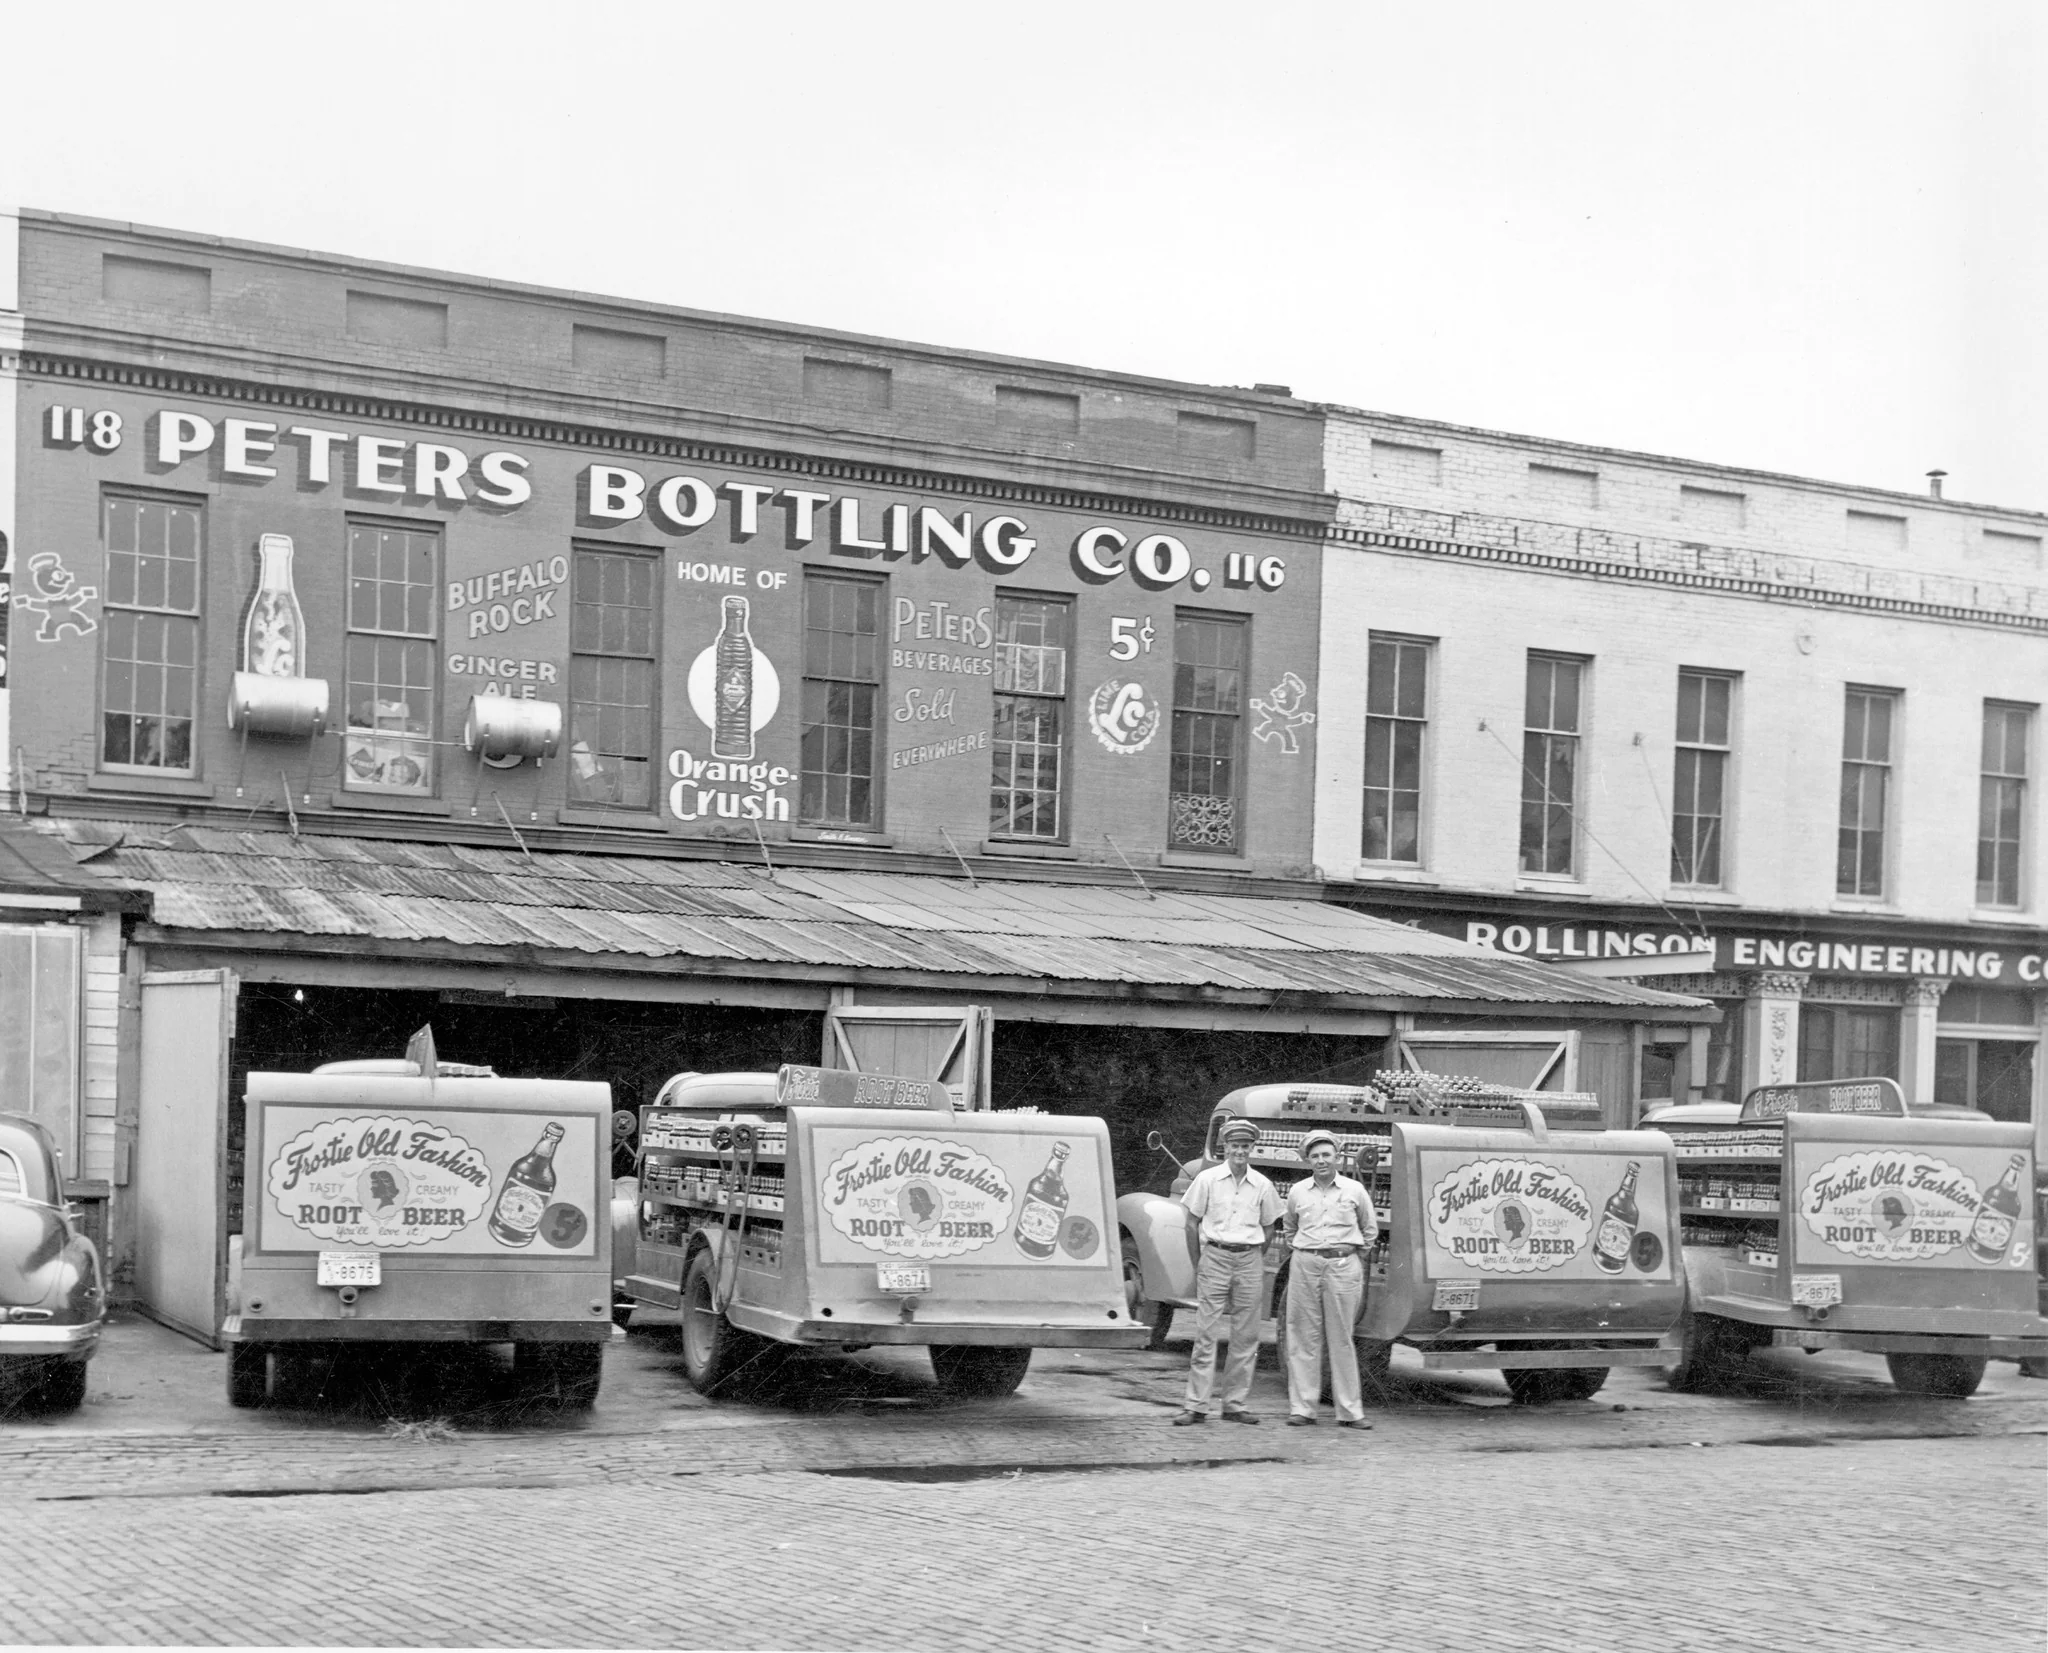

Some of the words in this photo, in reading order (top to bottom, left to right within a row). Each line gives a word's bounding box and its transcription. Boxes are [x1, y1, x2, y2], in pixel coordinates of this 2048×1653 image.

[49, 404, 122, 449] 118
[158, 409, 533, 506] PETERS
[589, 463, 1038, 567] BOTTLING
[1076, 525, 1212, 587] CO.
[1227, 551, 1287, 588] 116
[447, 554, 569, 612] BUFFALO
[677, 561, 747, 586] HOME
[756, 569, 789, 591] OF
[468, 588, 557, 640] ROCK
[1109, 615, 1156, 662] 5¢
[447, 652, 557, 685] GINGER
[891, 649, 993, 677] BEVERAGES
[894, 687, 957, 726] Sold
[1096, 679, 1121, 711] LIME
[1129, 710, 1156, 742] COLA
[891, 729, 990, 770] EVERYWHERE
[667, 748, 798, 793] Orange-
[667, 778, 790, 823] Crush
[1466, 921, 1718, 959] ROLLINSON
[1733, 937, 2005, 980] ENGINEERING
[2017, 954, 2048, 982] C
[853, 1075, 896, 1105] ROOT
[893, 1079, 931, 1107] BEER
[282, 1132, 354, 1190] Frostie
[356, 1125, 402, 1160] Old
[401, 1131, 488, 1188] Fashion
[308, 1181, 345, 1194] TASTY
[415, 1184, 460, 1197] CREAMY
[833, 1151, 892, 1206] Frostie
[894, 1146, 932, 1177] Old
[933, 1151, 1009, 1203] Fashion
[1810, 1164, 1868, 1214] Frostie
[1869, 1160, 1906, 1188] Old
[1907, 1164, 1980, 1213] Fashion
[856, 1197, 889, 1209] TASTY
[948, 1200, 987, 1211] CREAMY
[1438, 1171, 1489, 1225] Frostie
[1491, 1166, 1523, 1196] Old
[1525, 1171, 1590, 1221] Fashion
[298, 1204, 363, 1225] ROOT
[402, 1206, 466, 1227] BEER
[849, 1218, 906, 1238] ROOT
[939, 1221, 995, 1239] BEER
[1457, 1216, 1485, 1227] TASTY
[1536, 1218, 1570, 1229] CREAMY
[1833, 1206, 1863, 1217] TASTY
[1919, 1208, 1956, 1219] CREAMY
[378, 1226, 401, 1237] love
[1452, 1236, 1500, 1255] ROOT
[1529, 1238, 1576, 1255] BEER
[1824, 1225, 1877, 1243] ROOT
[1910, 1228, 1962, 1246] BEER
[1511, 1255, 1533, 1265] love
